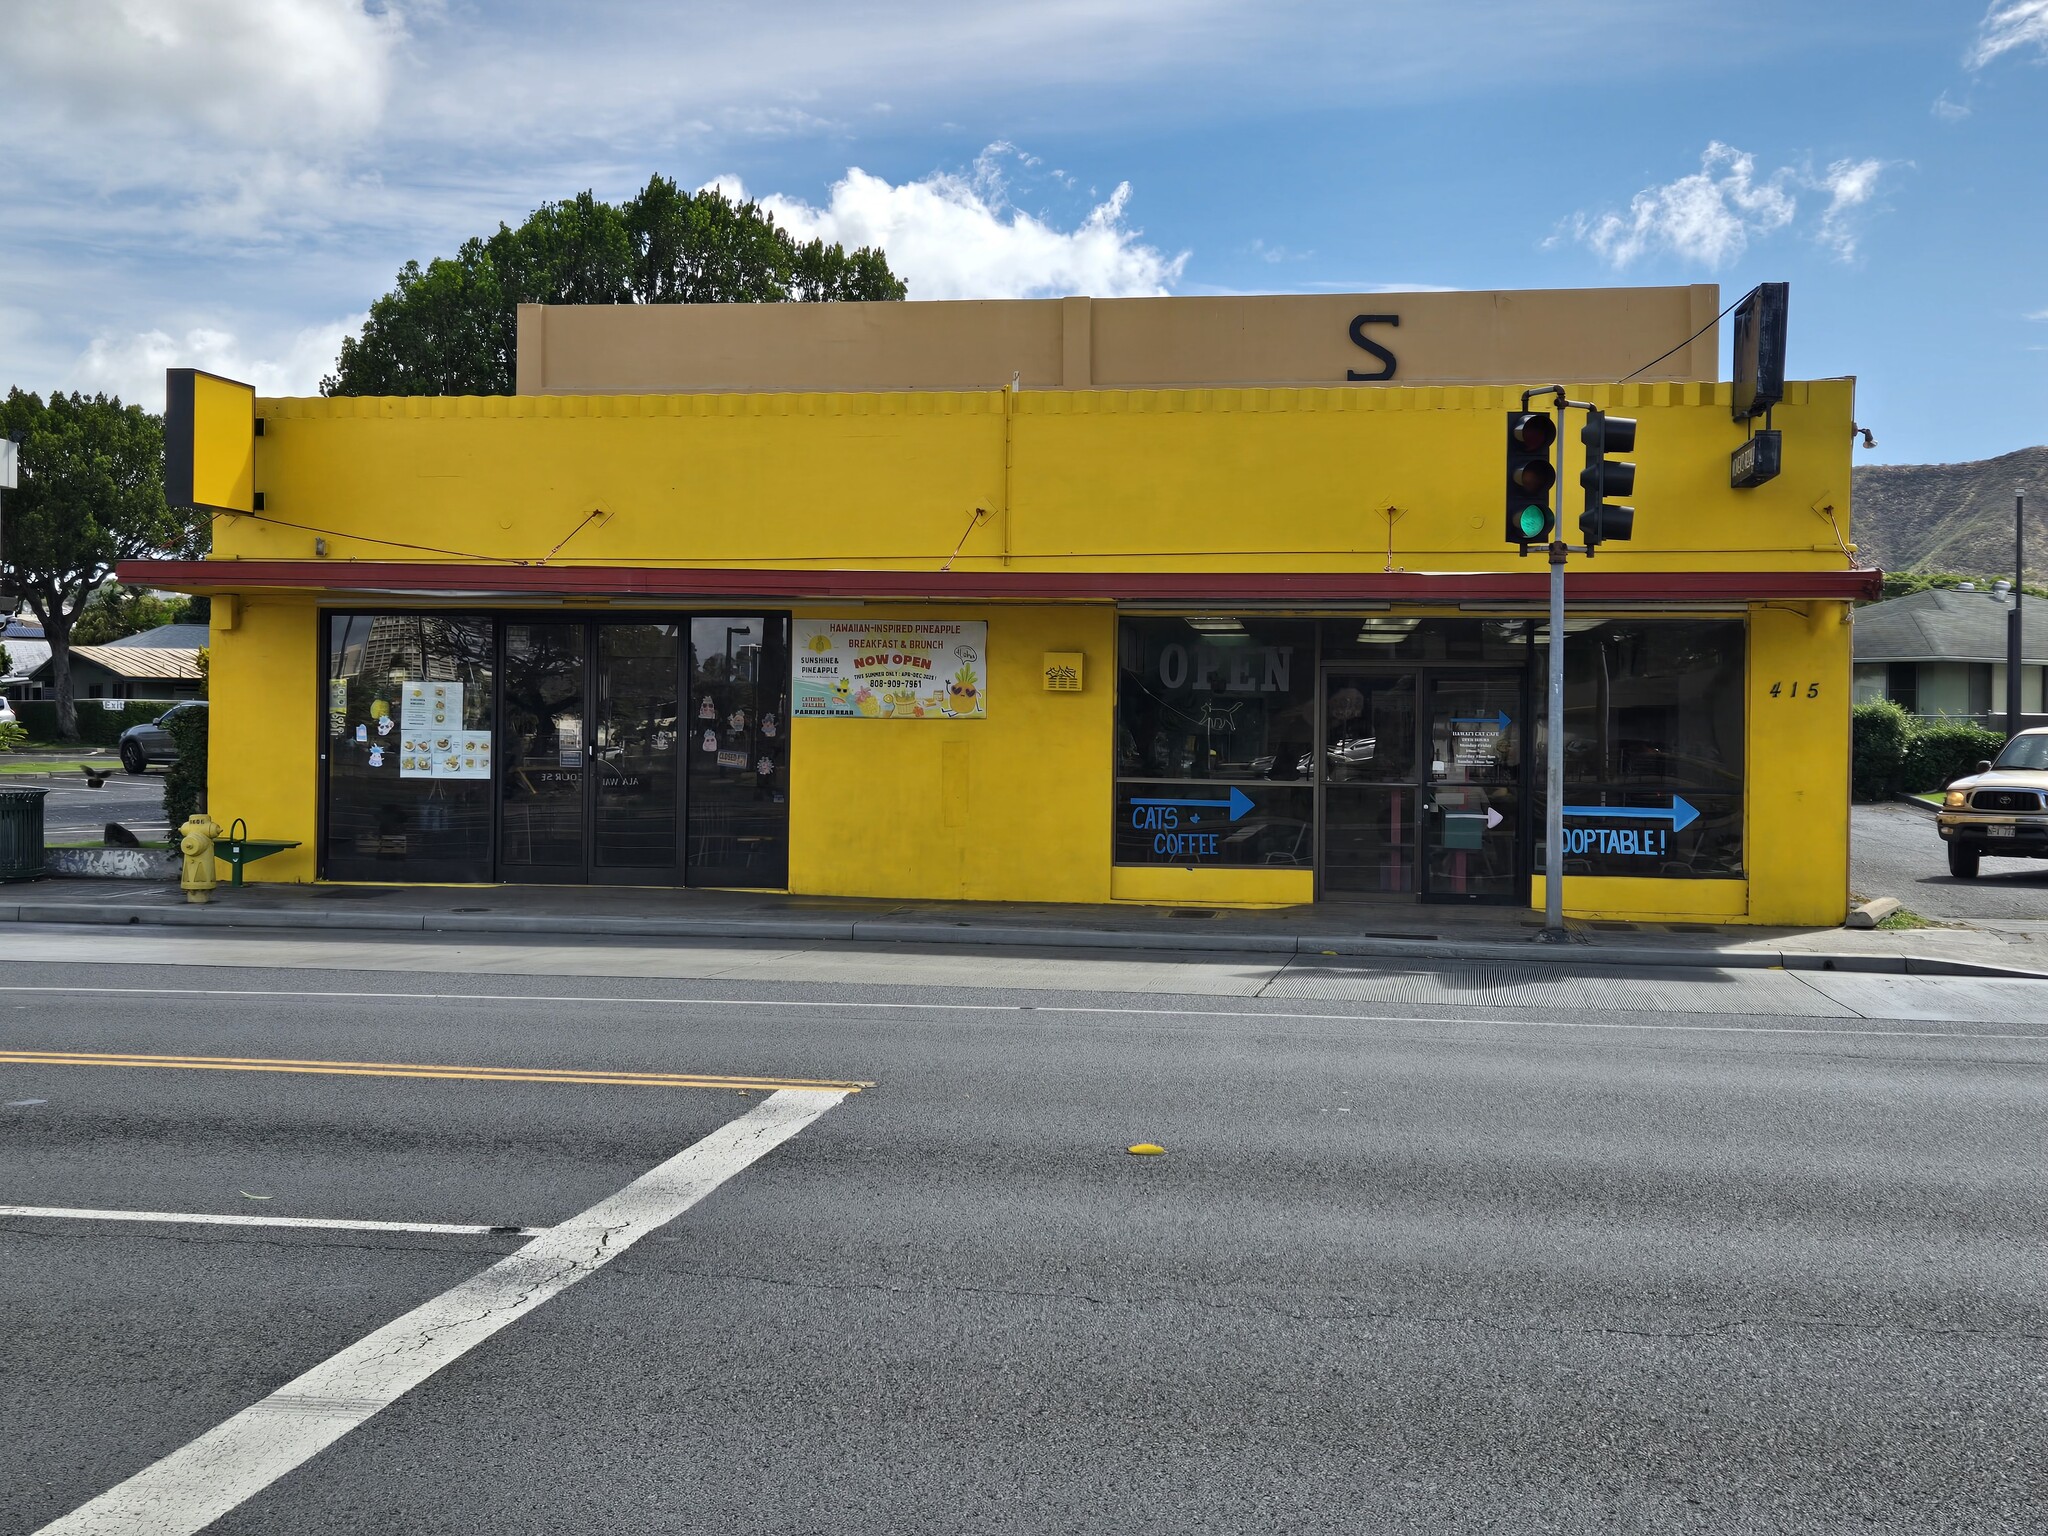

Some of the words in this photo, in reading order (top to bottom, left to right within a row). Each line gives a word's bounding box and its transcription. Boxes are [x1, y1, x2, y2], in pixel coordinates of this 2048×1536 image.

[1347, 314, 1399, 381] S
[830, 624, 912, 633] HAWAIIAN-INSPIRED
[916, 625, 960, 634] PINEAPPLE
[848, 639, 898, 648] BREAKFAST
[901, 640, 906, 648] &
[910, 640, 944, 649] BRUNCH
[854, 655, 890, 669] NOW
[892, 655, 932, 670] OPEN
[1160, 643, 1294, 692] OPEN
[870, 680, 922, 688] 808-909-7961
[1770, 682, 1820, 698] 415
[1132, 806, 1178, 830] CATS
[1154, 833, 1219, 855] COFFEE
[1562, 829, 1666, 856] DOPTABLE!
